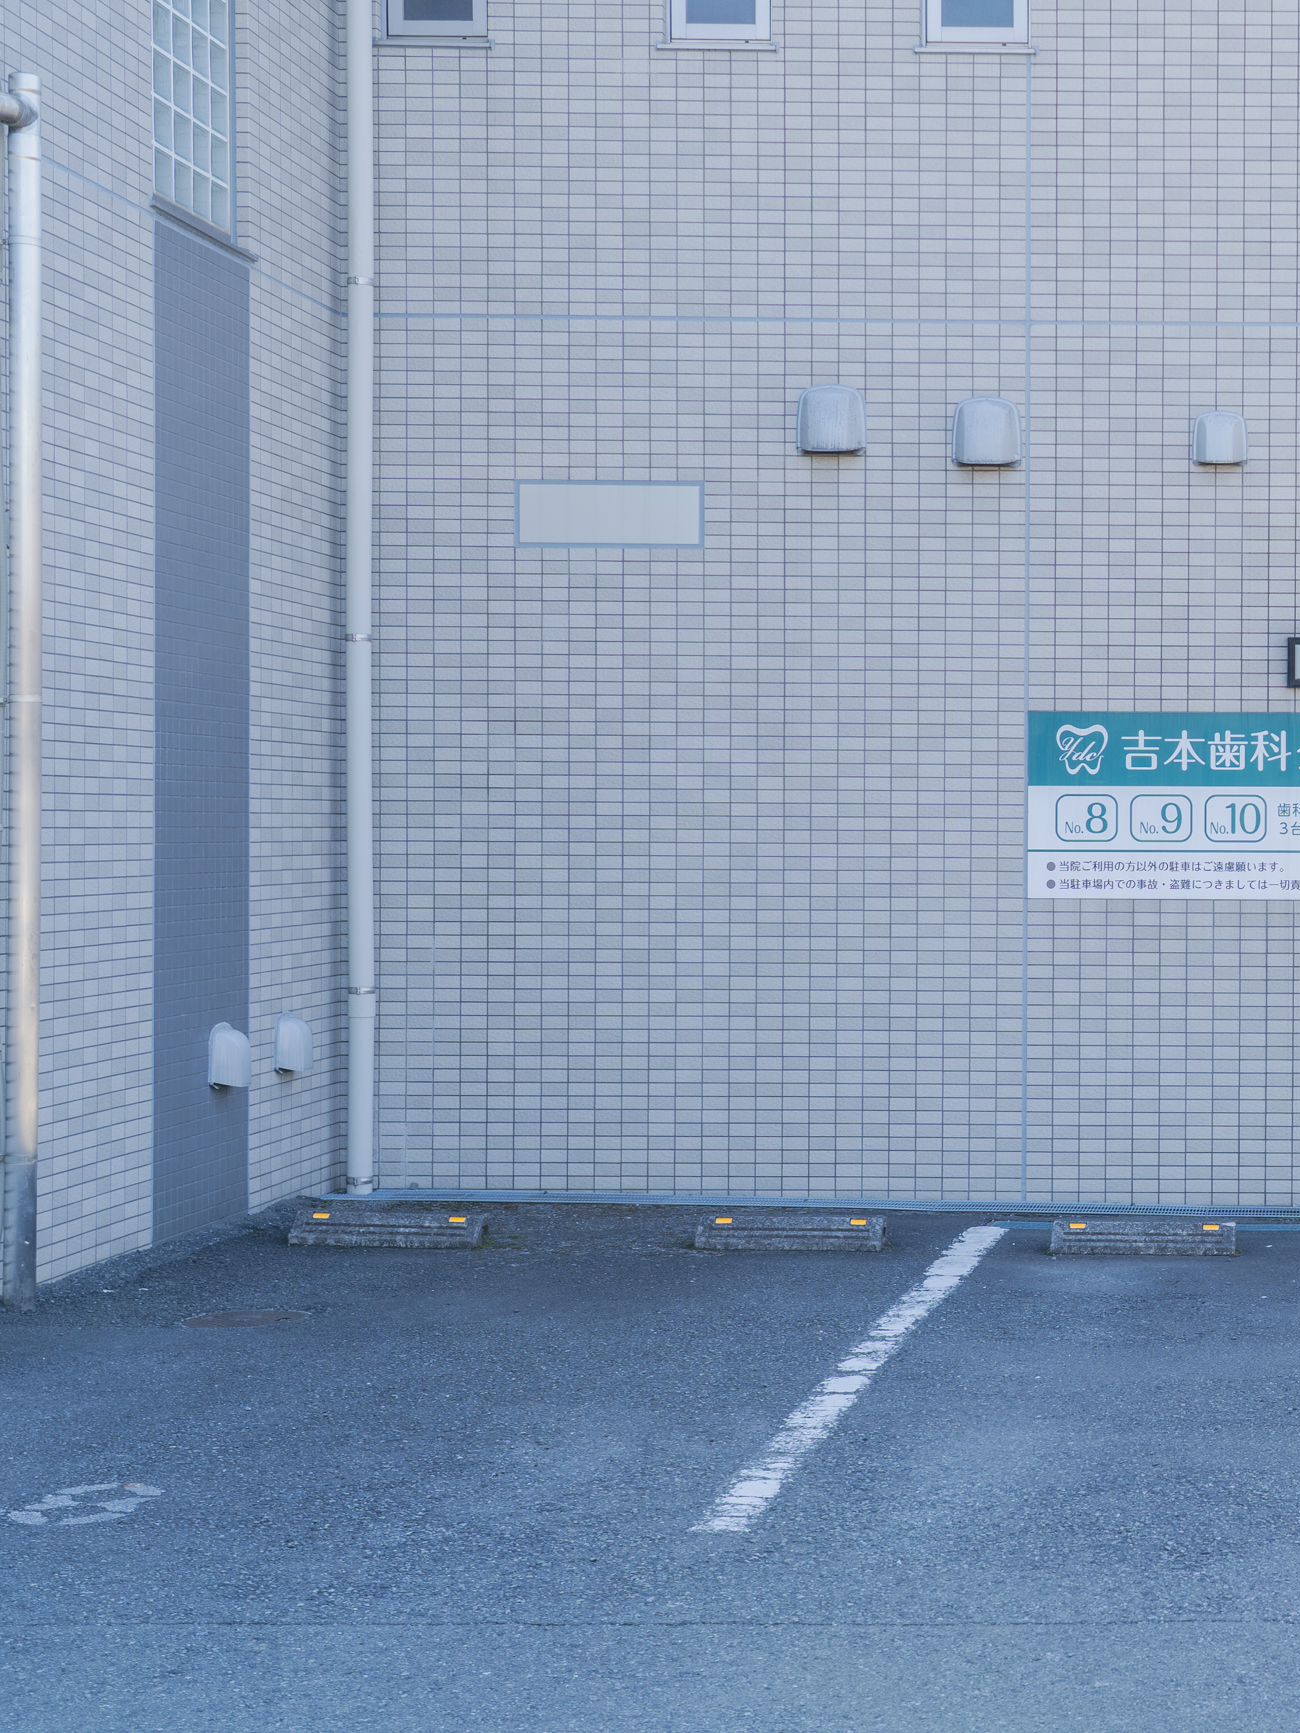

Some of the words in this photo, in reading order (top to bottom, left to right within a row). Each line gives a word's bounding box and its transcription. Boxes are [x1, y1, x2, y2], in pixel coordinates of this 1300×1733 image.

[1058, 861, 1285, 873] 当院ご利用の方以外の駐車はご遠慮願います。
